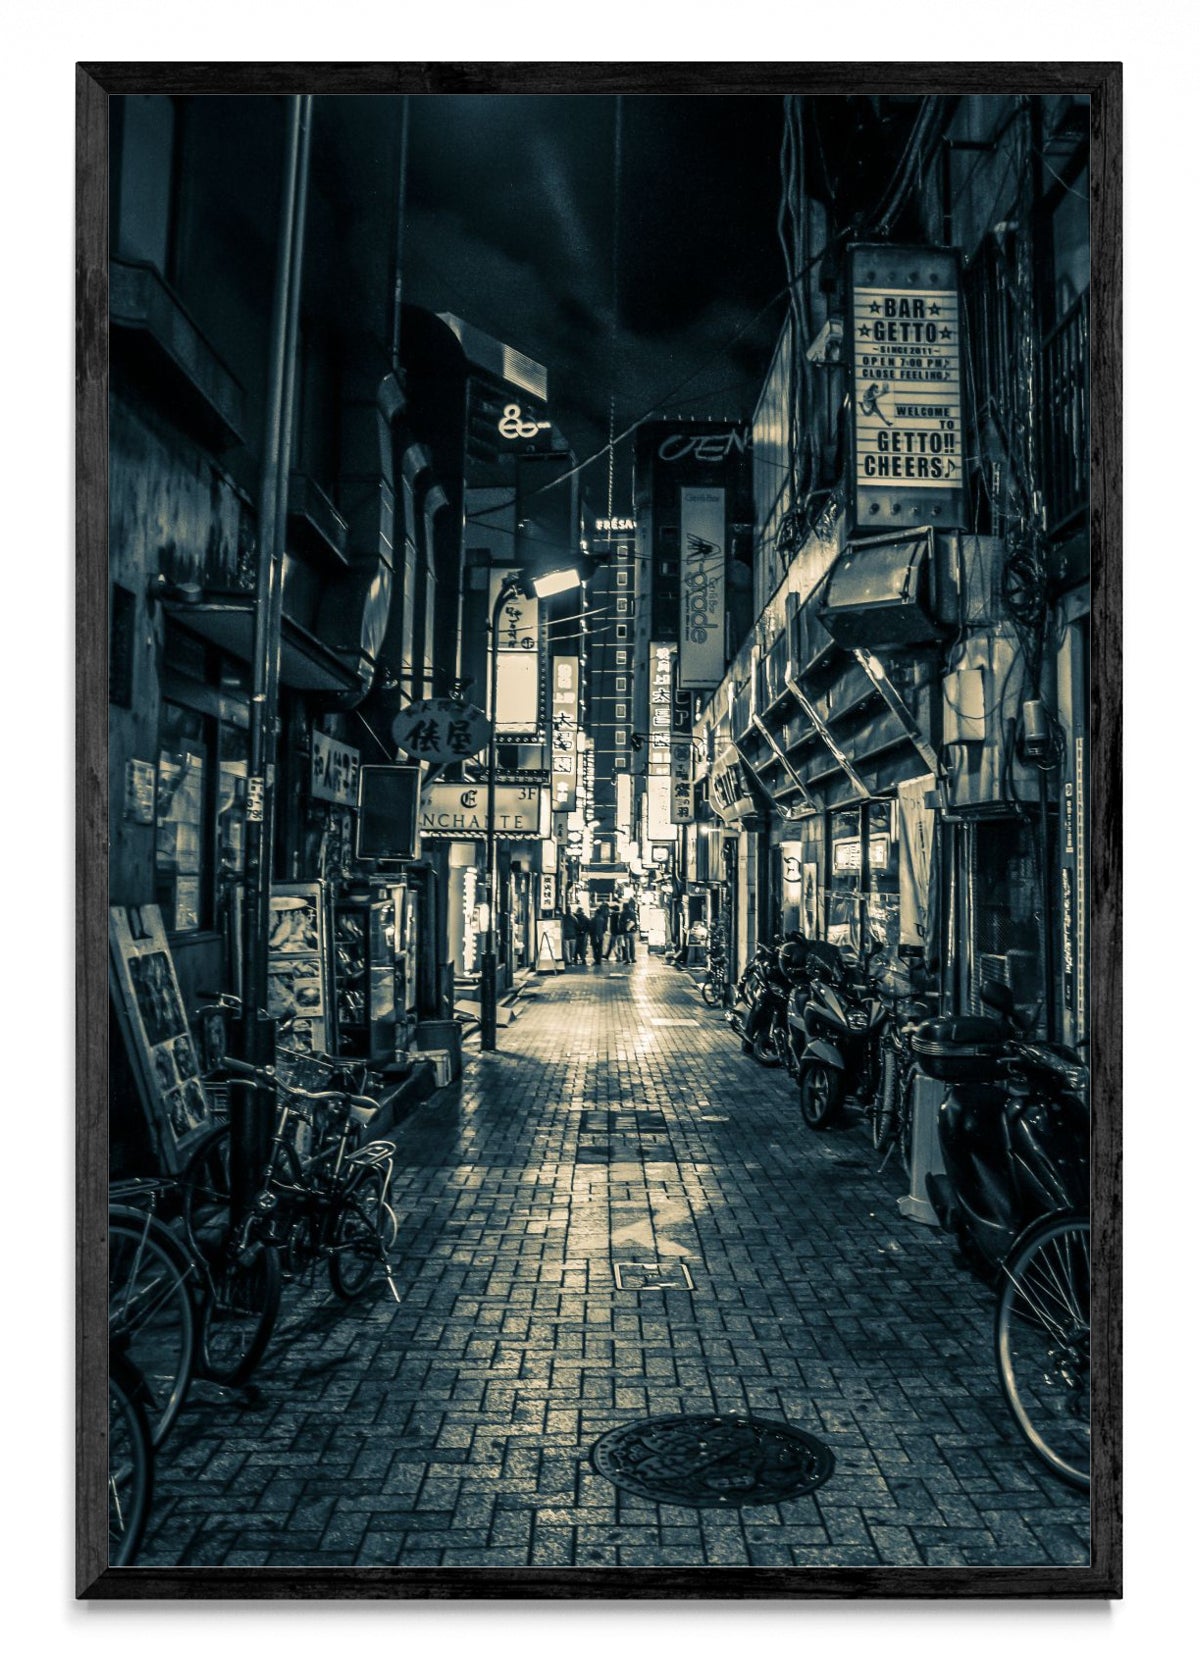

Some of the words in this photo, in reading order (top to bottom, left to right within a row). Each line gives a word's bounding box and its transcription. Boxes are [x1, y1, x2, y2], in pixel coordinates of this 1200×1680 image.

[884, 298, 925, 318] BAR
[873, 321, 936, 343] GETTO
[863, 357, 894, 366] OPEN
[900, 358, 922, 367] 7:00
[862, 369, 894, 378] CLOSE
[896, 407, 949, 416] WELCOME
[939, 421, 954, 429] TO
[877, 431, 955, 453] GETTO!!
[864, 455, 942, 478] CHEERS
[518, 788, 537, 800] 3F
